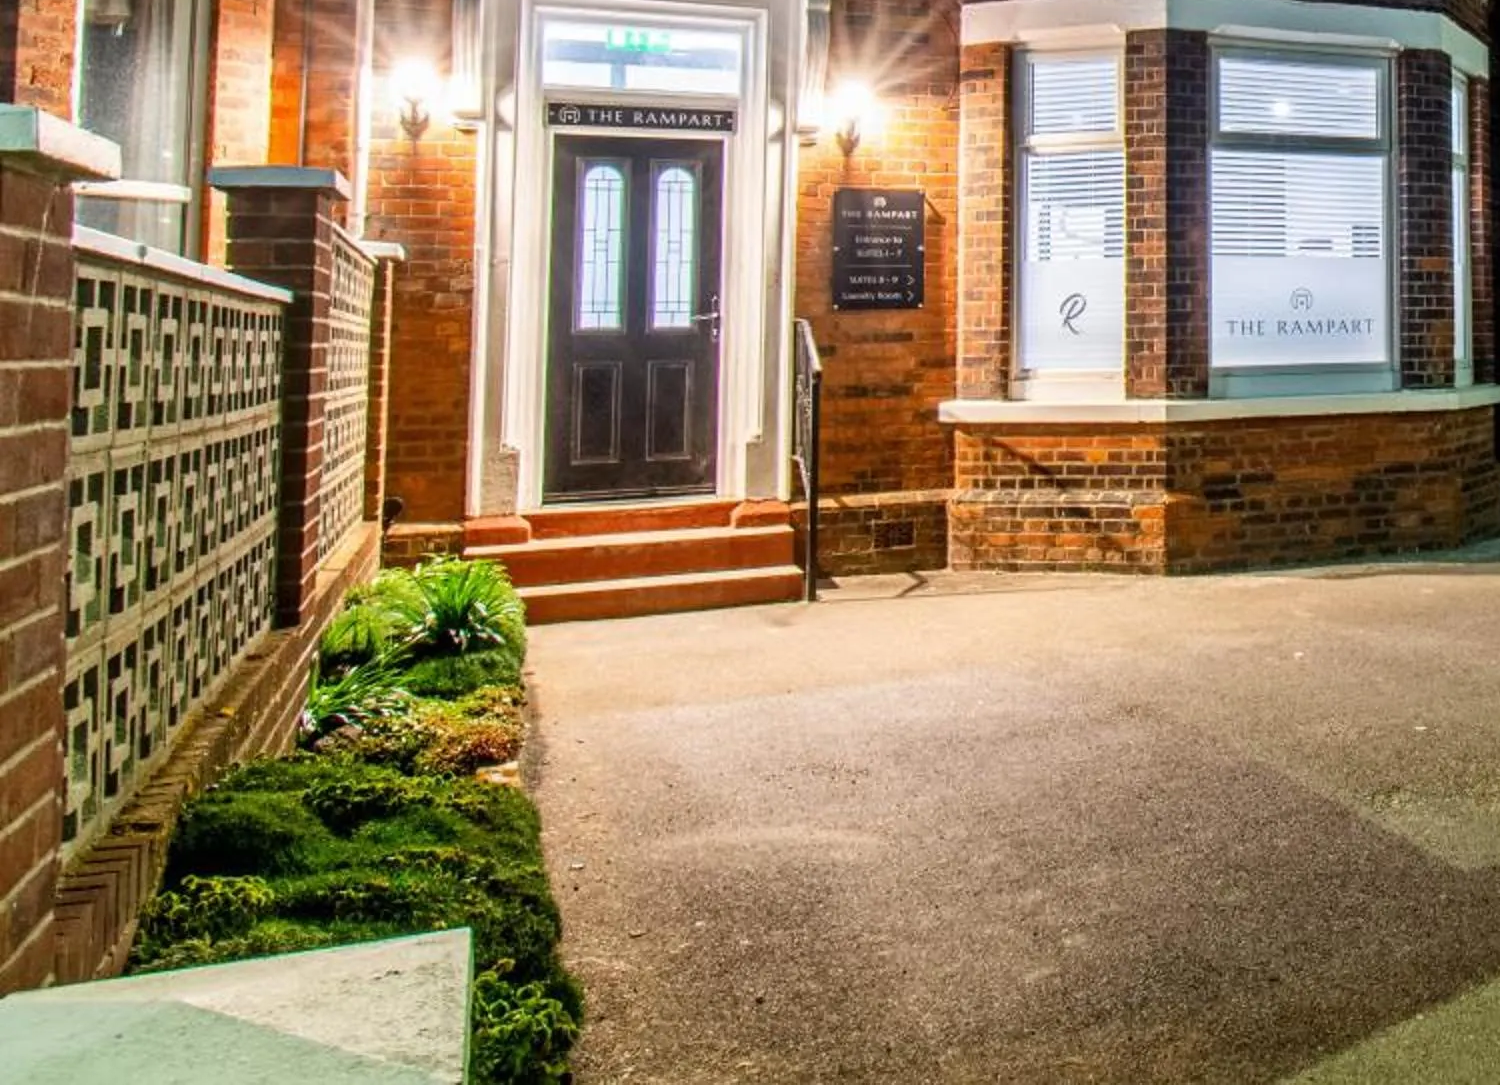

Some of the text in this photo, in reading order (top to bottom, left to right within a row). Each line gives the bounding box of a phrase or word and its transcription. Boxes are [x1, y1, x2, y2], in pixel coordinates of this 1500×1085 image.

[587, 109, 723, 128] THE RAMPART
[867, 210, 918, 220] RAMPART
[1060, 293, 1087, 335] R
[1225, 318, 1374, 336] THE RAMPART
